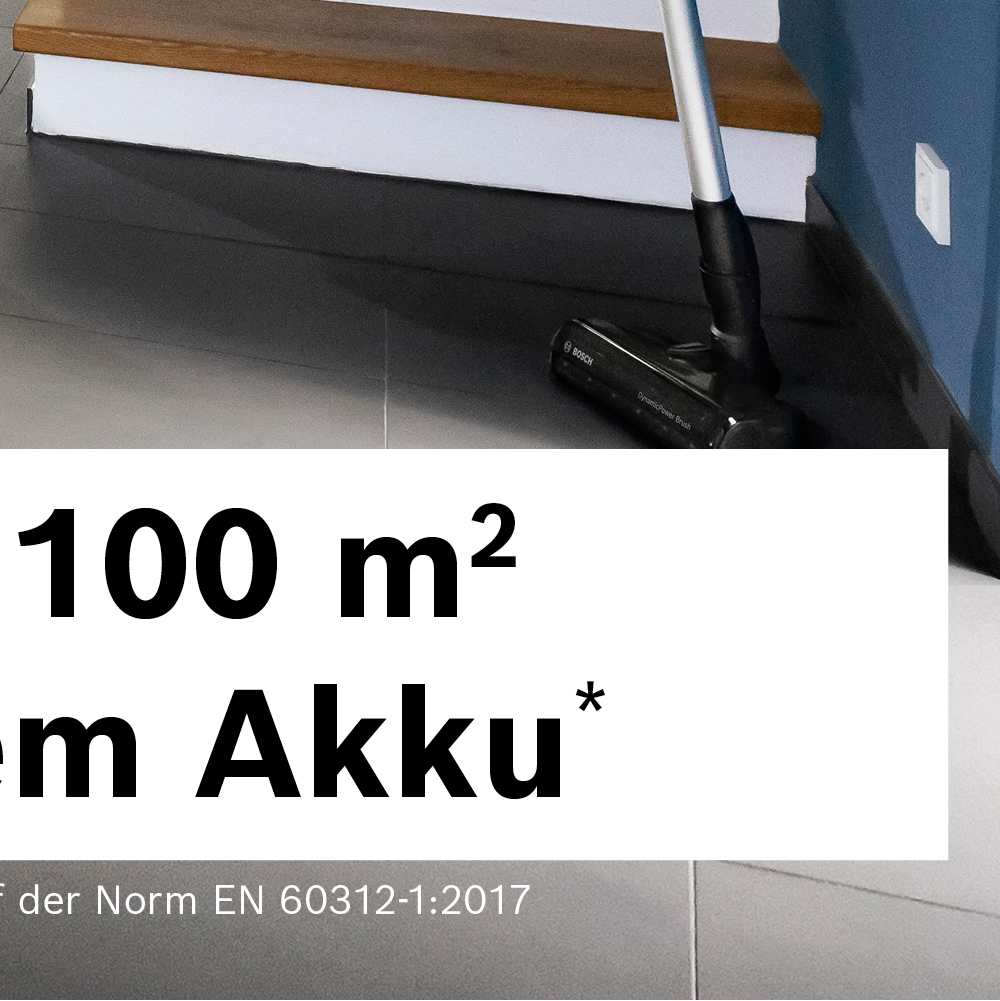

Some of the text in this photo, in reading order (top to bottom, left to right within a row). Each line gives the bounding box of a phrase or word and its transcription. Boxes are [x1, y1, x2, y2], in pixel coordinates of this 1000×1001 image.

[572, 346, 594, 366] BOSCH
[637, 391, 691, 430] DynamicPower Brush
